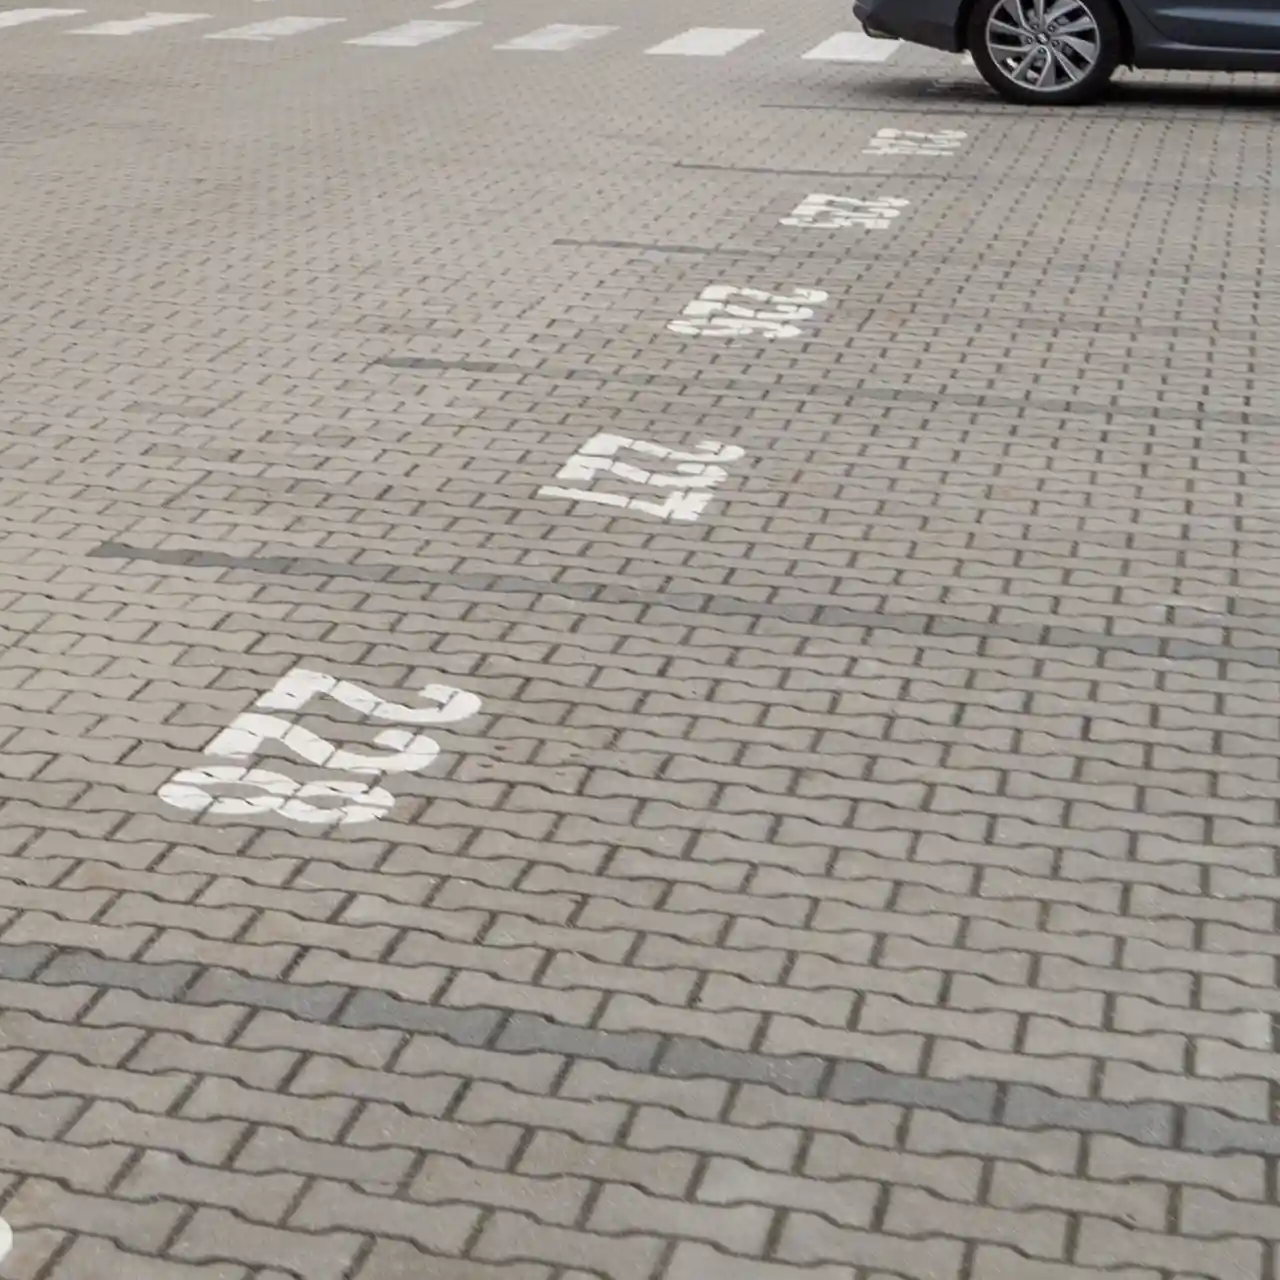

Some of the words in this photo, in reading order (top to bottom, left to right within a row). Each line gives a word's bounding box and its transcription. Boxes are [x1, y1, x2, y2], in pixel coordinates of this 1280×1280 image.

[666, 284, 830, 339] 226
[537, 432, 745, 521] 227
[156, 667, 482, 825] 228
